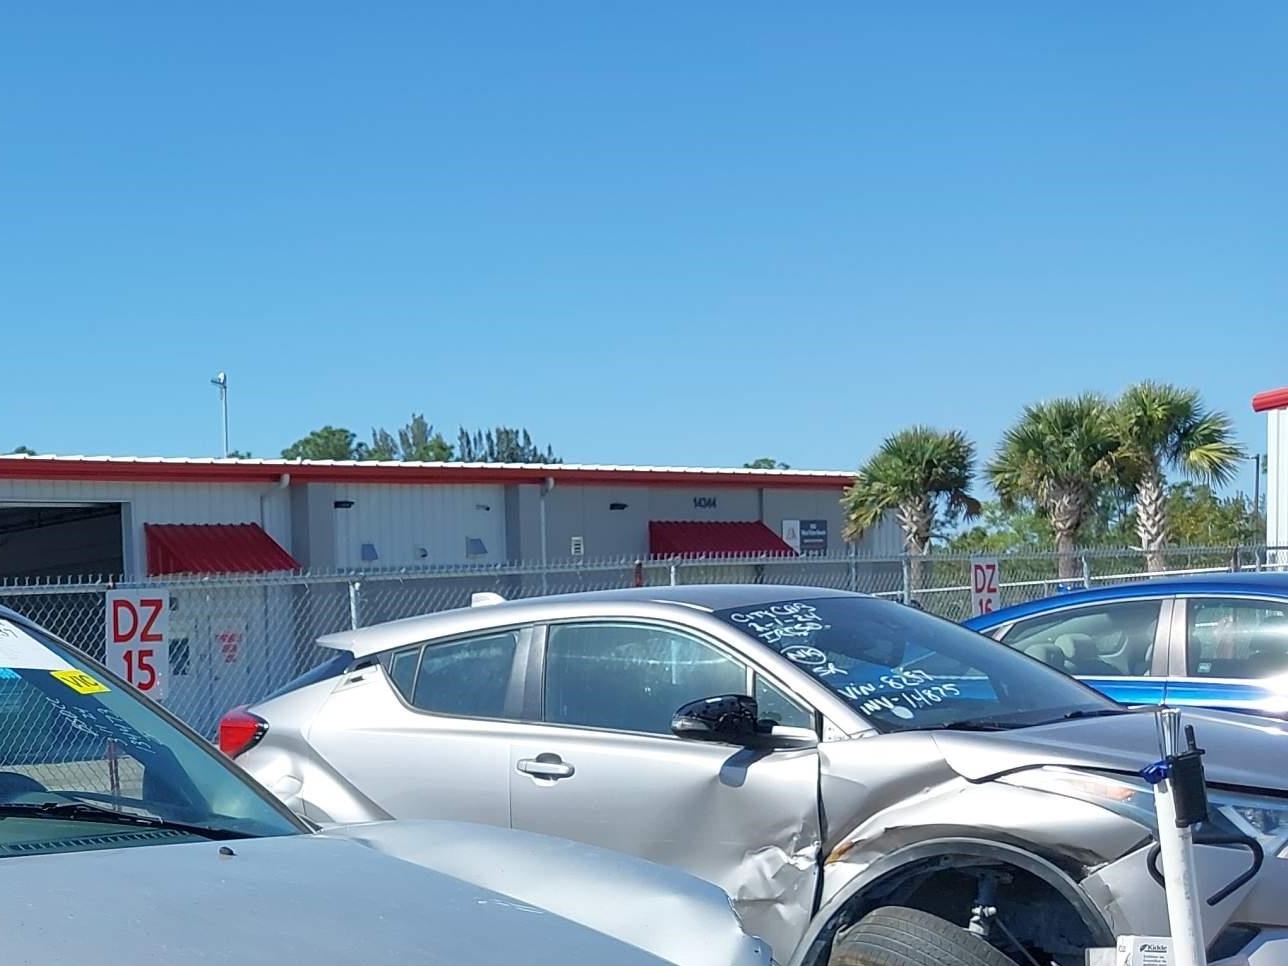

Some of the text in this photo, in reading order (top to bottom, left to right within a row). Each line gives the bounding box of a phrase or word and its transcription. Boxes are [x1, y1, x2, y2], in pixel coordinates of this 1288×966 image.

[974, 564, 998, 594] DZ
[112, 598, 165, 644] DZ
[122, 650, 158, 692] 15
